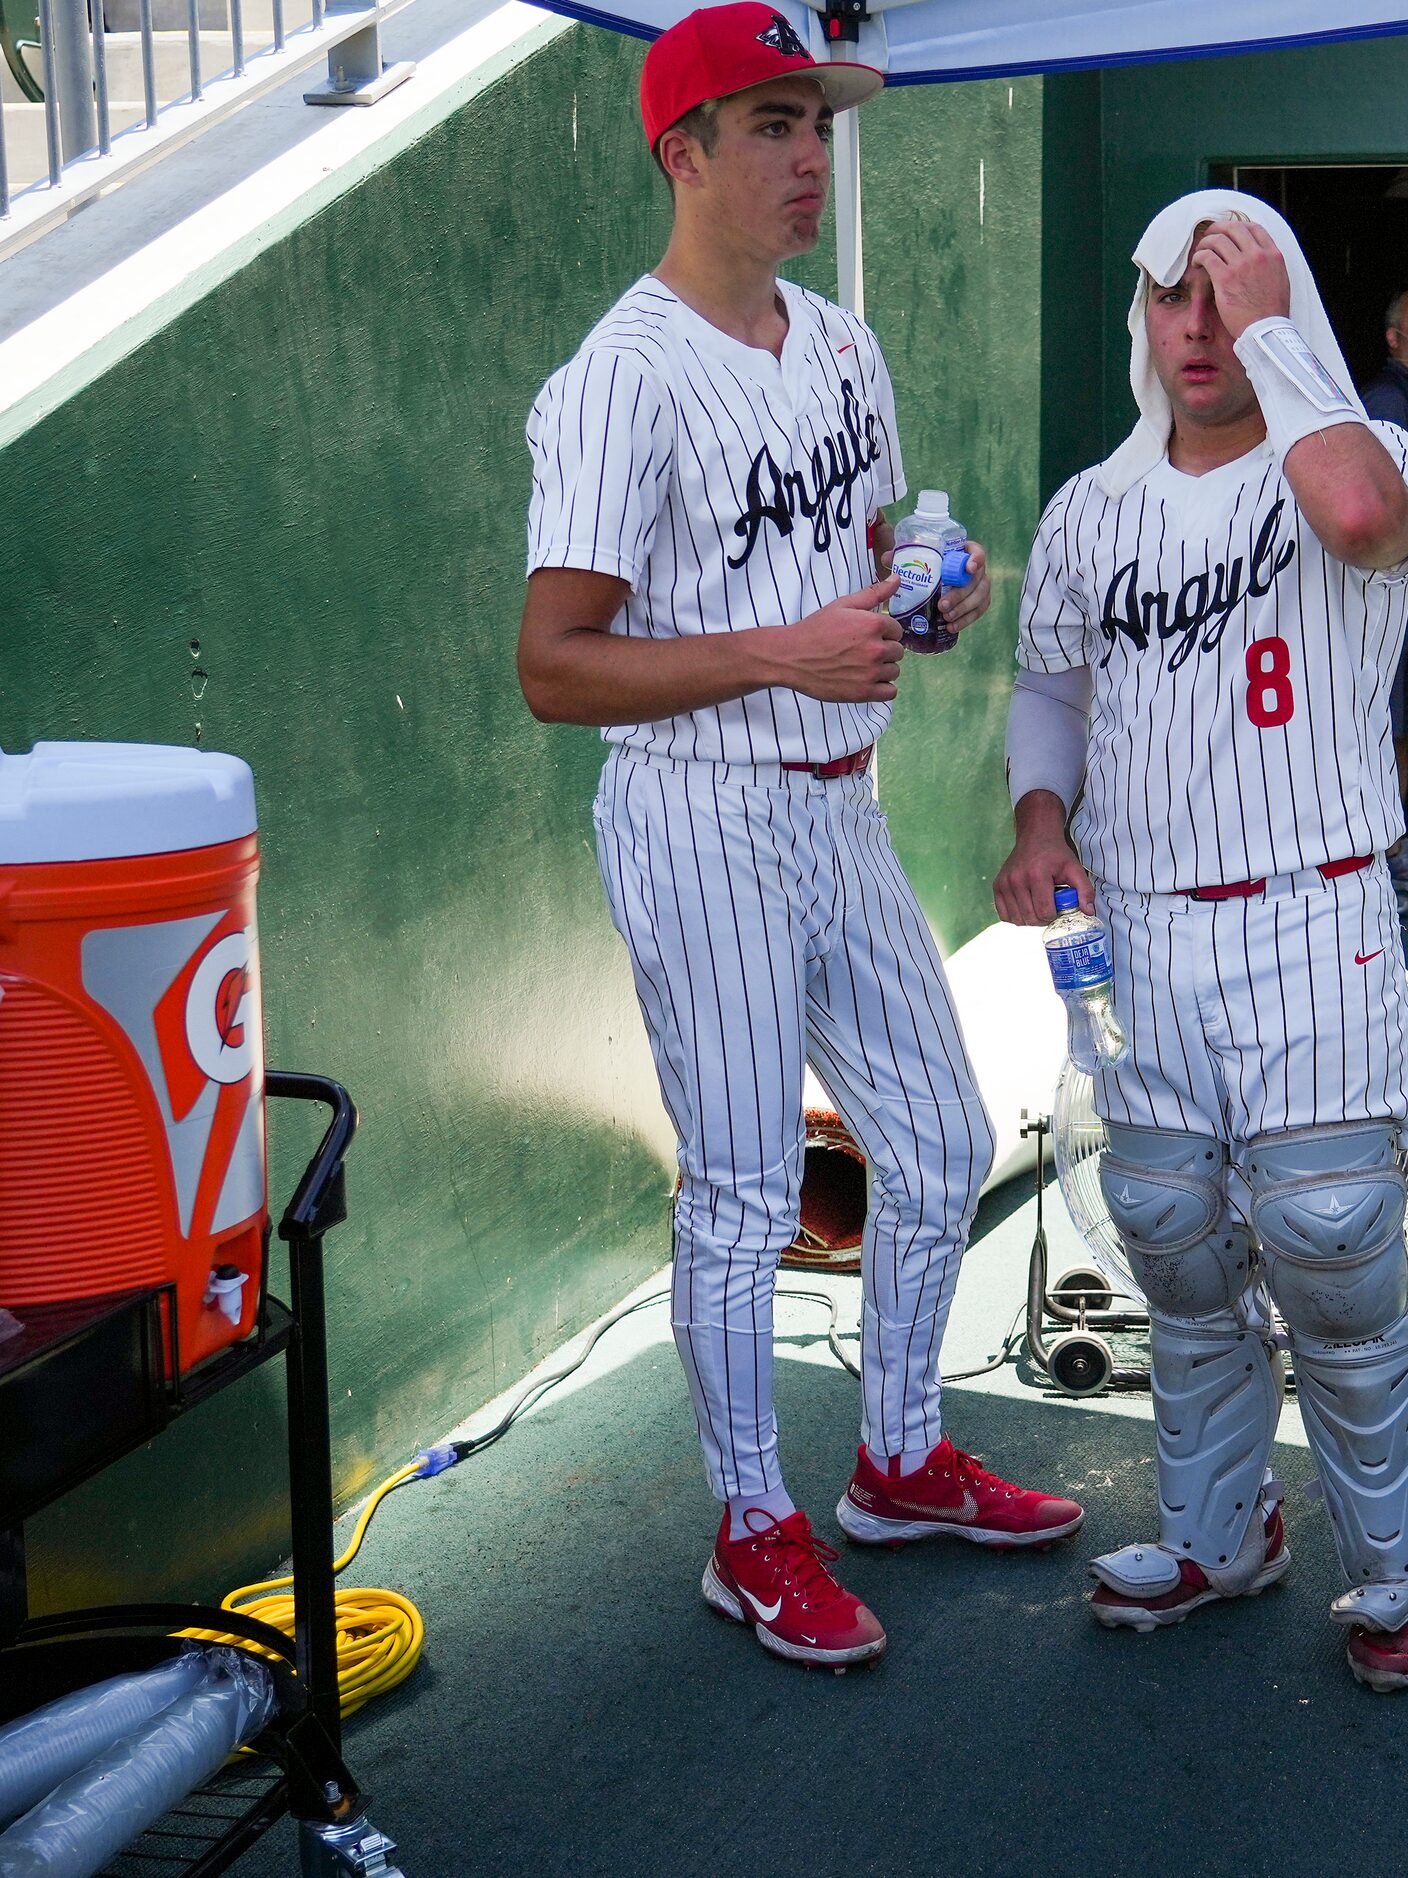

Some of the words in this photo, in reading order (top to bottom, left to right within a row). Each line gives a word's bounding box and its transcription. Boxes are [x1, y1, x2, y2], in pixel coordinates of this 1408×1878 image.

[892, 563, 934, 584] Electrolit
[1245, 636, 1295, 729] 8
[1073, 948, 1089, 958] DEJA
[1076, 956, 1090, 968] BLUE
